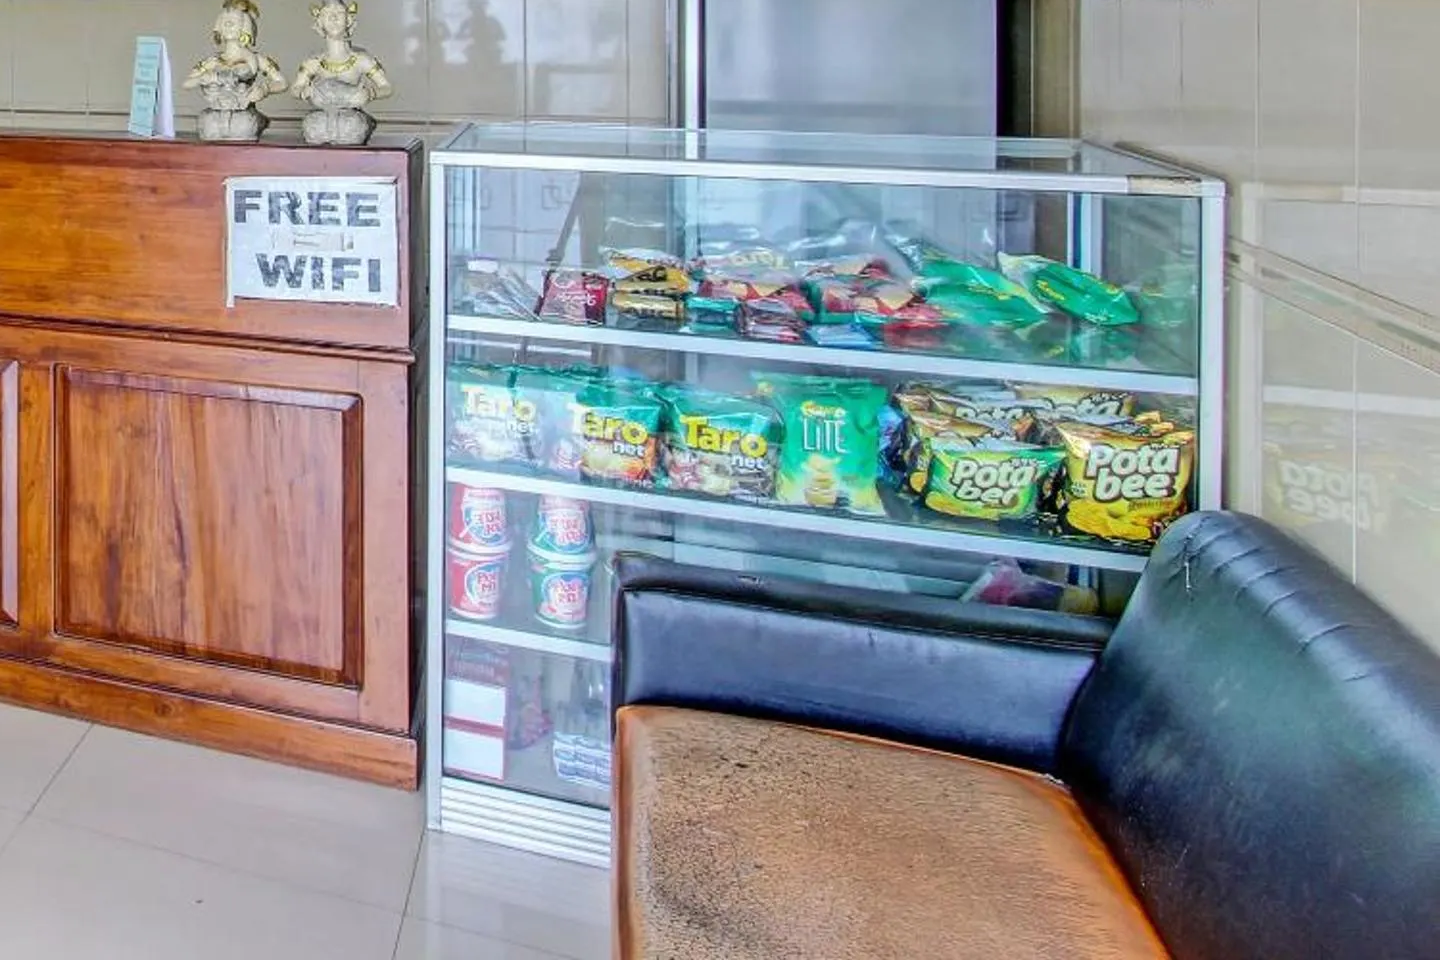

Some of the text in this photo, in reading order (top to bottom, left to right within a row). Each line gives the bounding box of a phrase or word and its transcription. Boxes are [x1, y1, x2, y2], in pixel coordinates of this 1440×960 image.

[234, 190, 380, 227] FREE
[256, 253, 381, 292] WIFI
[567, 404, 649, 445] Taro
[680, 416, 768, 459] Taro
[731, 455, 766, 471] net
[952, 460, 1035, 489] Pota
[1085, 444, 1180, 477] Pota
[1095, 468, 1169, 501] bee
